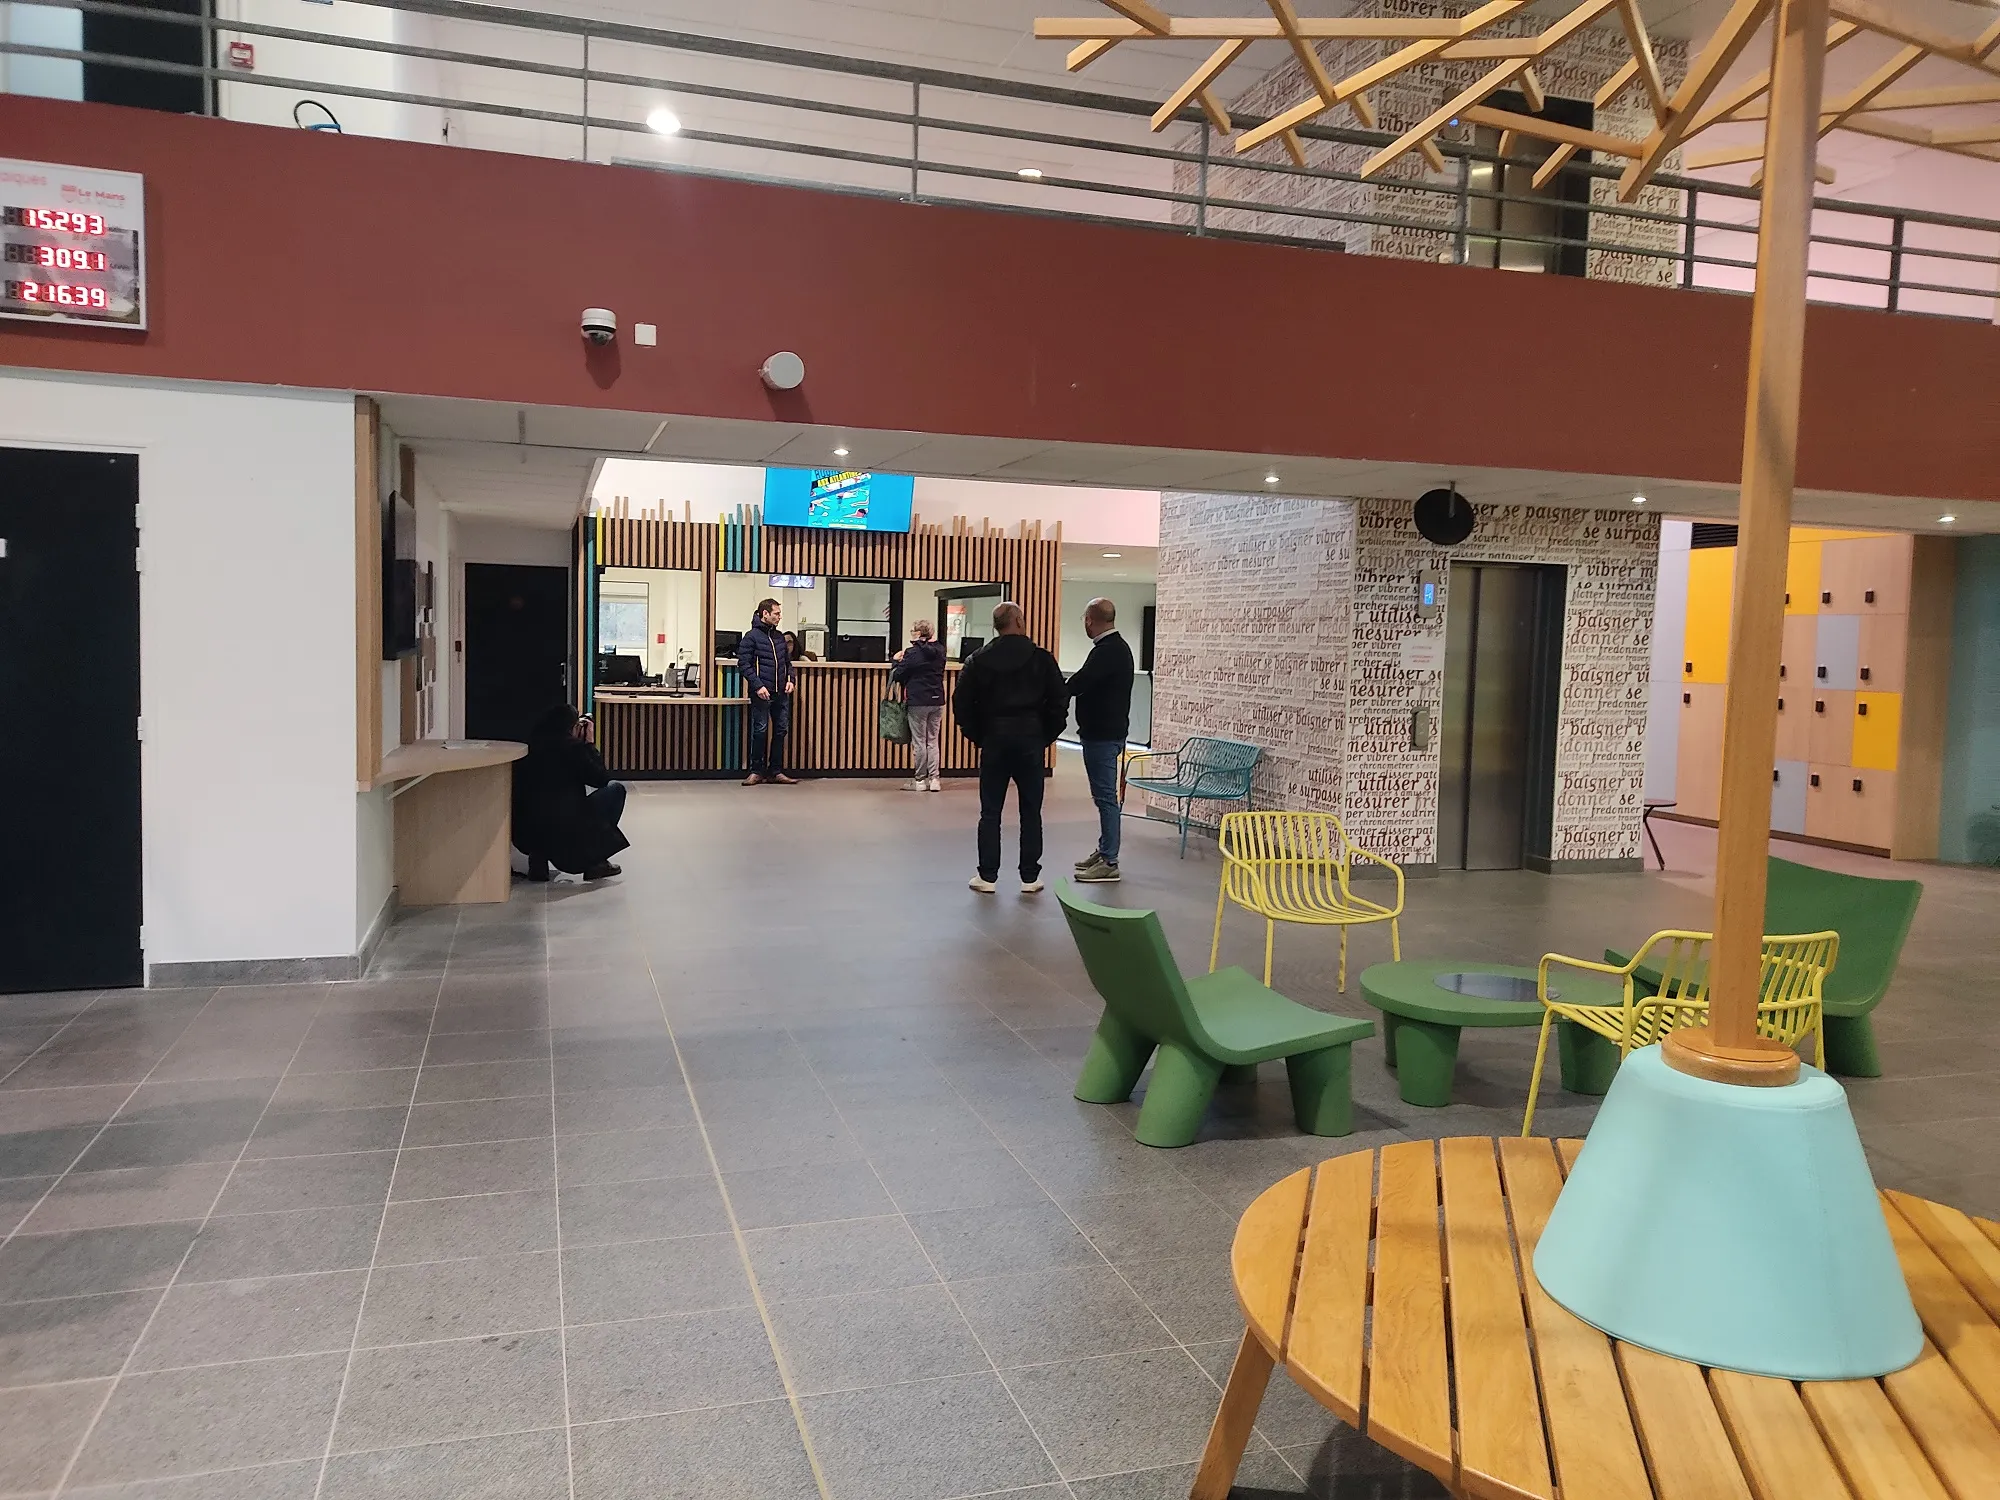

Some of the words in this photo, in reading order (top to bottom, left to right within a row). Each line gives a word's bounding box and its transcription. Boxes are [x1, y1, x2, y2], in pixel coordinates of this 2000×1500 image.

[1656, 268, 1673, 282] se
[1503, 503, 1520, 518] se
[1360, 515, 1413, 530] vibrer
[1316, 529, 1346, 545] vibrer
[1473, 533, 1511, 543] sourire
[1583, 526, 1600, 539] se
[1325, 549, 1336, 561] se
[1404, 548, 1450, 558] marcher
[1430, 555, 1449, 571] ut
[1587, 560, 1636, 577] vibrer
[1378, 582, 1410, 594] vibrer
[1572, 588, 1604, 602] flotter
[1251, 621, 1276, 634] vibrer
[1279, 622, 1315, 634] mesurer
[1576, 612, 1639, 632] baigner
[1570, 630, 1628, 646] donner
[1632, 634, 1650, 646] se
[1598, 643, 1649, 656] fredonner
[1274, 655, 1309, 675] baigner
[1311, 656, 1341, 672] vibrer
[1363, 664, 1424, 680] utiliser
[1237, 671, 1271, 686] mesurer
[1320, 678, 1331, 690] se
[1570, 667, 1632, 686] baigner
[1637, 670, 1650, 683] vi
[1563, 683, 1622, 699] donner
[1625, 687, 1643, 700] se
[1350, 698, 1369, 708] per
[1371, 696, 1403, 707] vibrer
[1597, 699, 1648, 712] fredonner
[1252, 706, 1282, 723] utiliser
[1285, 712, 1294, 725] se
[1296, 710, 1333, 731] baigner
[1232, 719, 1257, 735] vibrer
[1258, 725, 1294, 742] mesurer
[1570, 721, 1630, 740] baigner
[1563, 738, 1622, 753] donner
[1625, 740, 1643, 753] se
[1366, 751, 1398, 762] vibrer
[1400, 753, 1438, 762] sourire
[1591, 752, 1642, 764] fredonner
[1308, 768, 1343, 787] utiliser
[1358, 776, 1419, 791] utiliser
[1563, 773, 1625, 793] baigner
[1629, 777, 1643, 789] vi
[1288, 783, 1298, 795] se
[1557, 791, 1616, 806] donner
[1618, 793, 1636, 806] se
[1346, 809, 1364, 820] per
[1366, 807, 1398, 818] vibrer
[1591, 805, 1641, 818] fredonner
[1358, 832, 1419, 847] utiliser
[1563, 828, 1625, 847] baigner
[1557, 845, 1615, 860] donner
[1619, 847, 1635, 859] se
